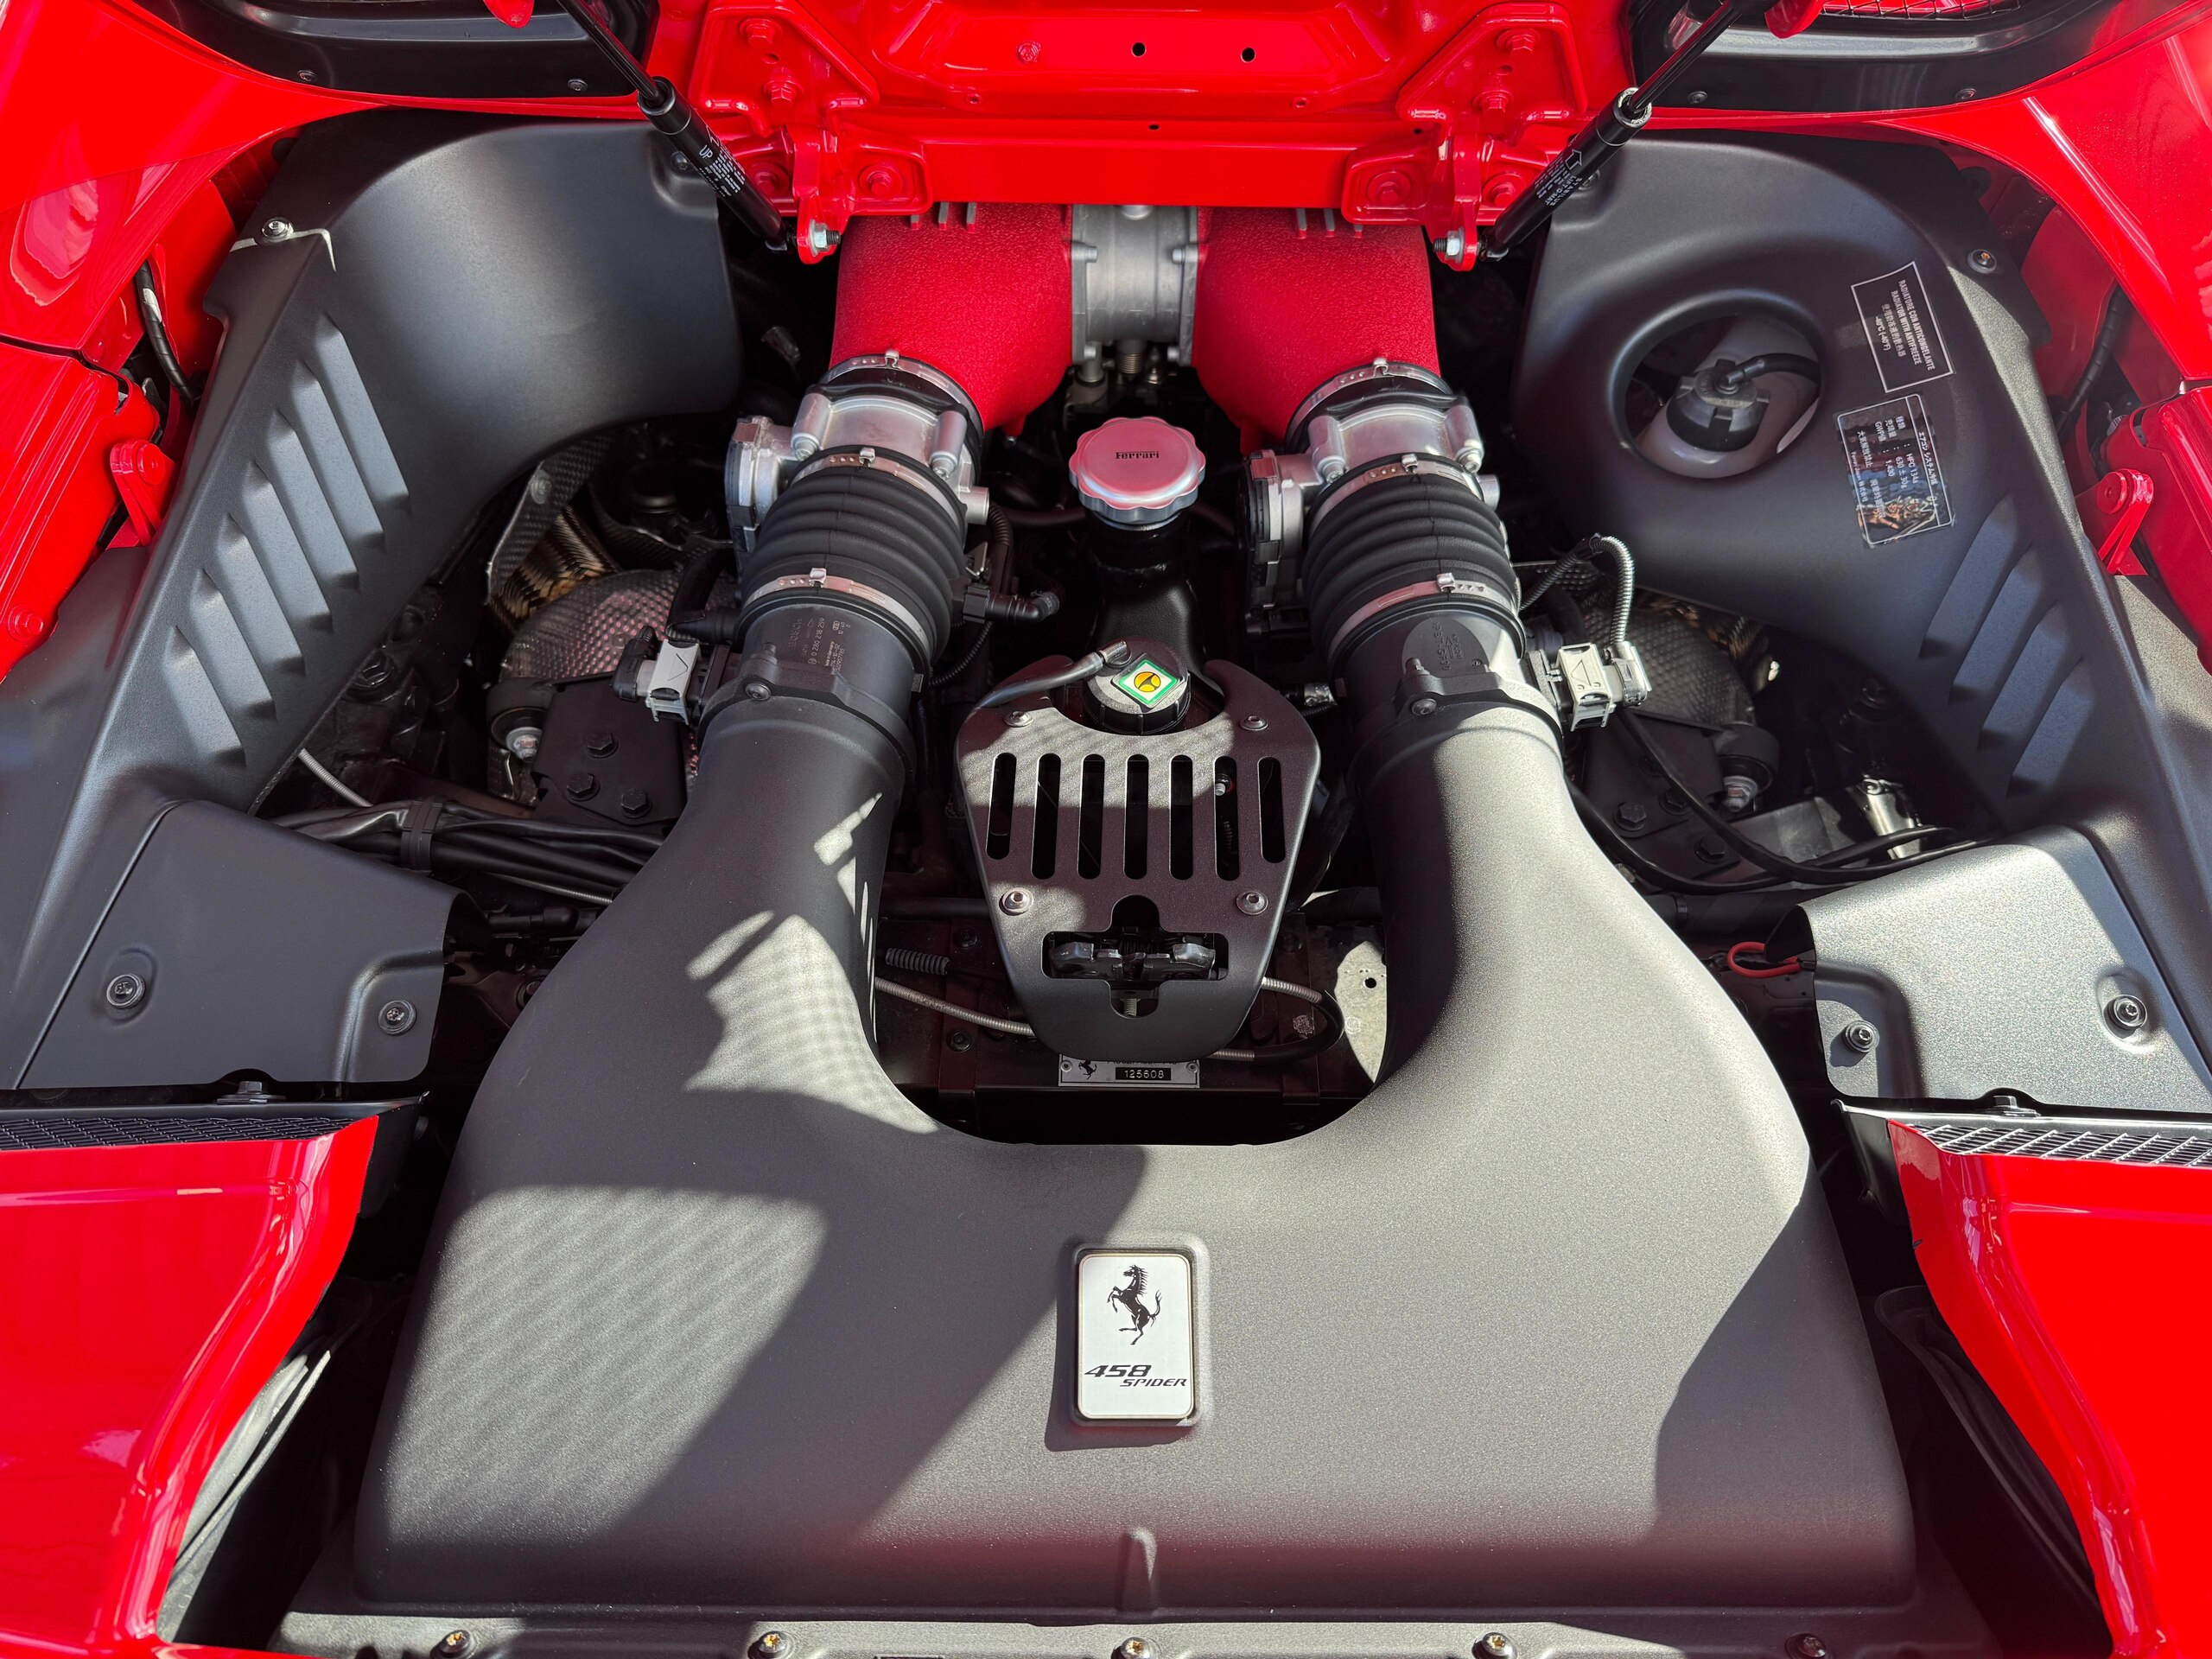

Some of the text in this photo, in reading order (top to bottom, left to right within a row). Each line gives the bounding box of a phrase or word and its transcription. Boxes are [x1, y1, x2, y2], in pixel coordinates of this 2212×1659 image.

[698, 144, 714, 161] UP
[1549, 177, 1582, 207] STABILUS
[1891, 289, 1922, 365] RADIATOR WITH ANTIFREEZE
[1897, 279, 1935, 370] RADIATORE CON ANTICONGELANTE
[1115, 450, 1160, 459] Ferrari
[1894, 455, 1904, 468] 630
[1904, 453, 1914, 467] HFC
[1909, 468, 1918, 484] 134a
[1898, 475, 1910, 489] 30g
[1124, 1070, 1165, 1079] 125608
[1084, 1364, 1152, 1377] 458
[1120, 1378, 1187, 1387] SPIDER
